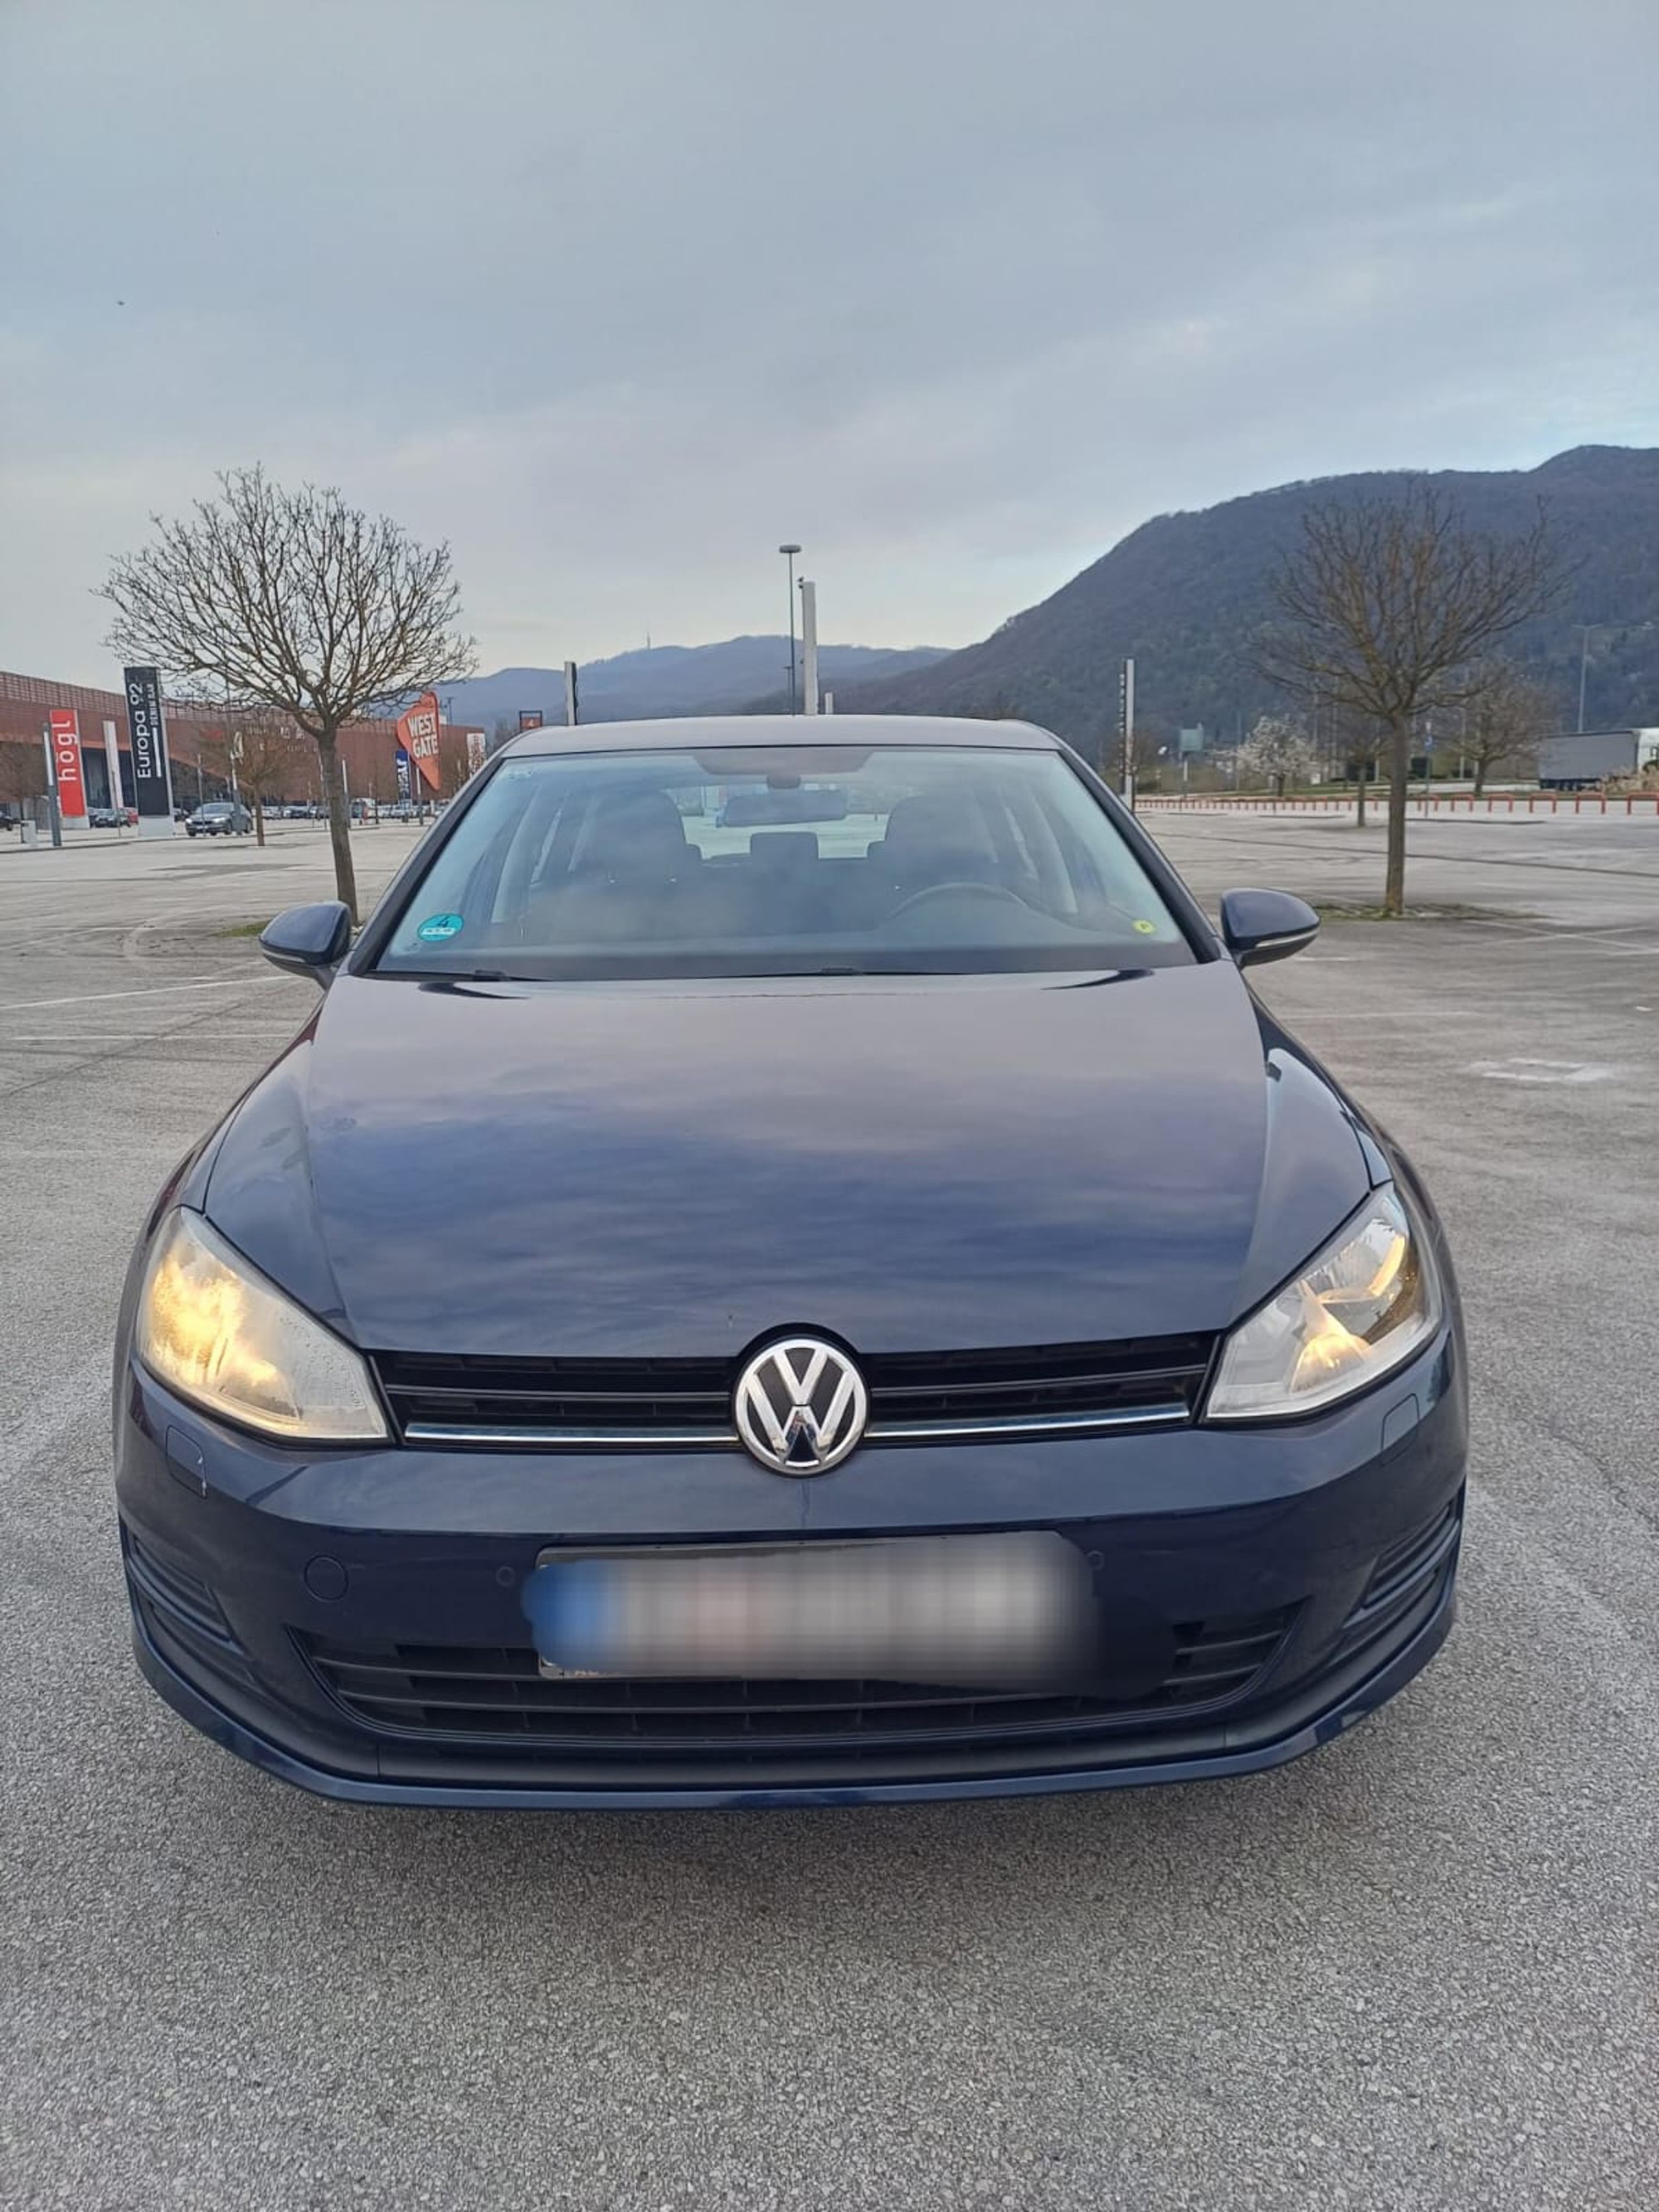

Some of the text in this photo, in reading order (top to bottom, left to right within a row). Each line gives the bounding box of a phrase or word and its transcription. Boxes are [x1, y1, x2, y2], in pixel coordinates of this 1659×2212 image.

[51, 719, 78, 781] högl
[129, 683, 151, 778] Europa 92
[407, 713, 436, 738] WEST
[412, 735, 439, 758] GATE
[744, 1344, 858, 1465] VW
